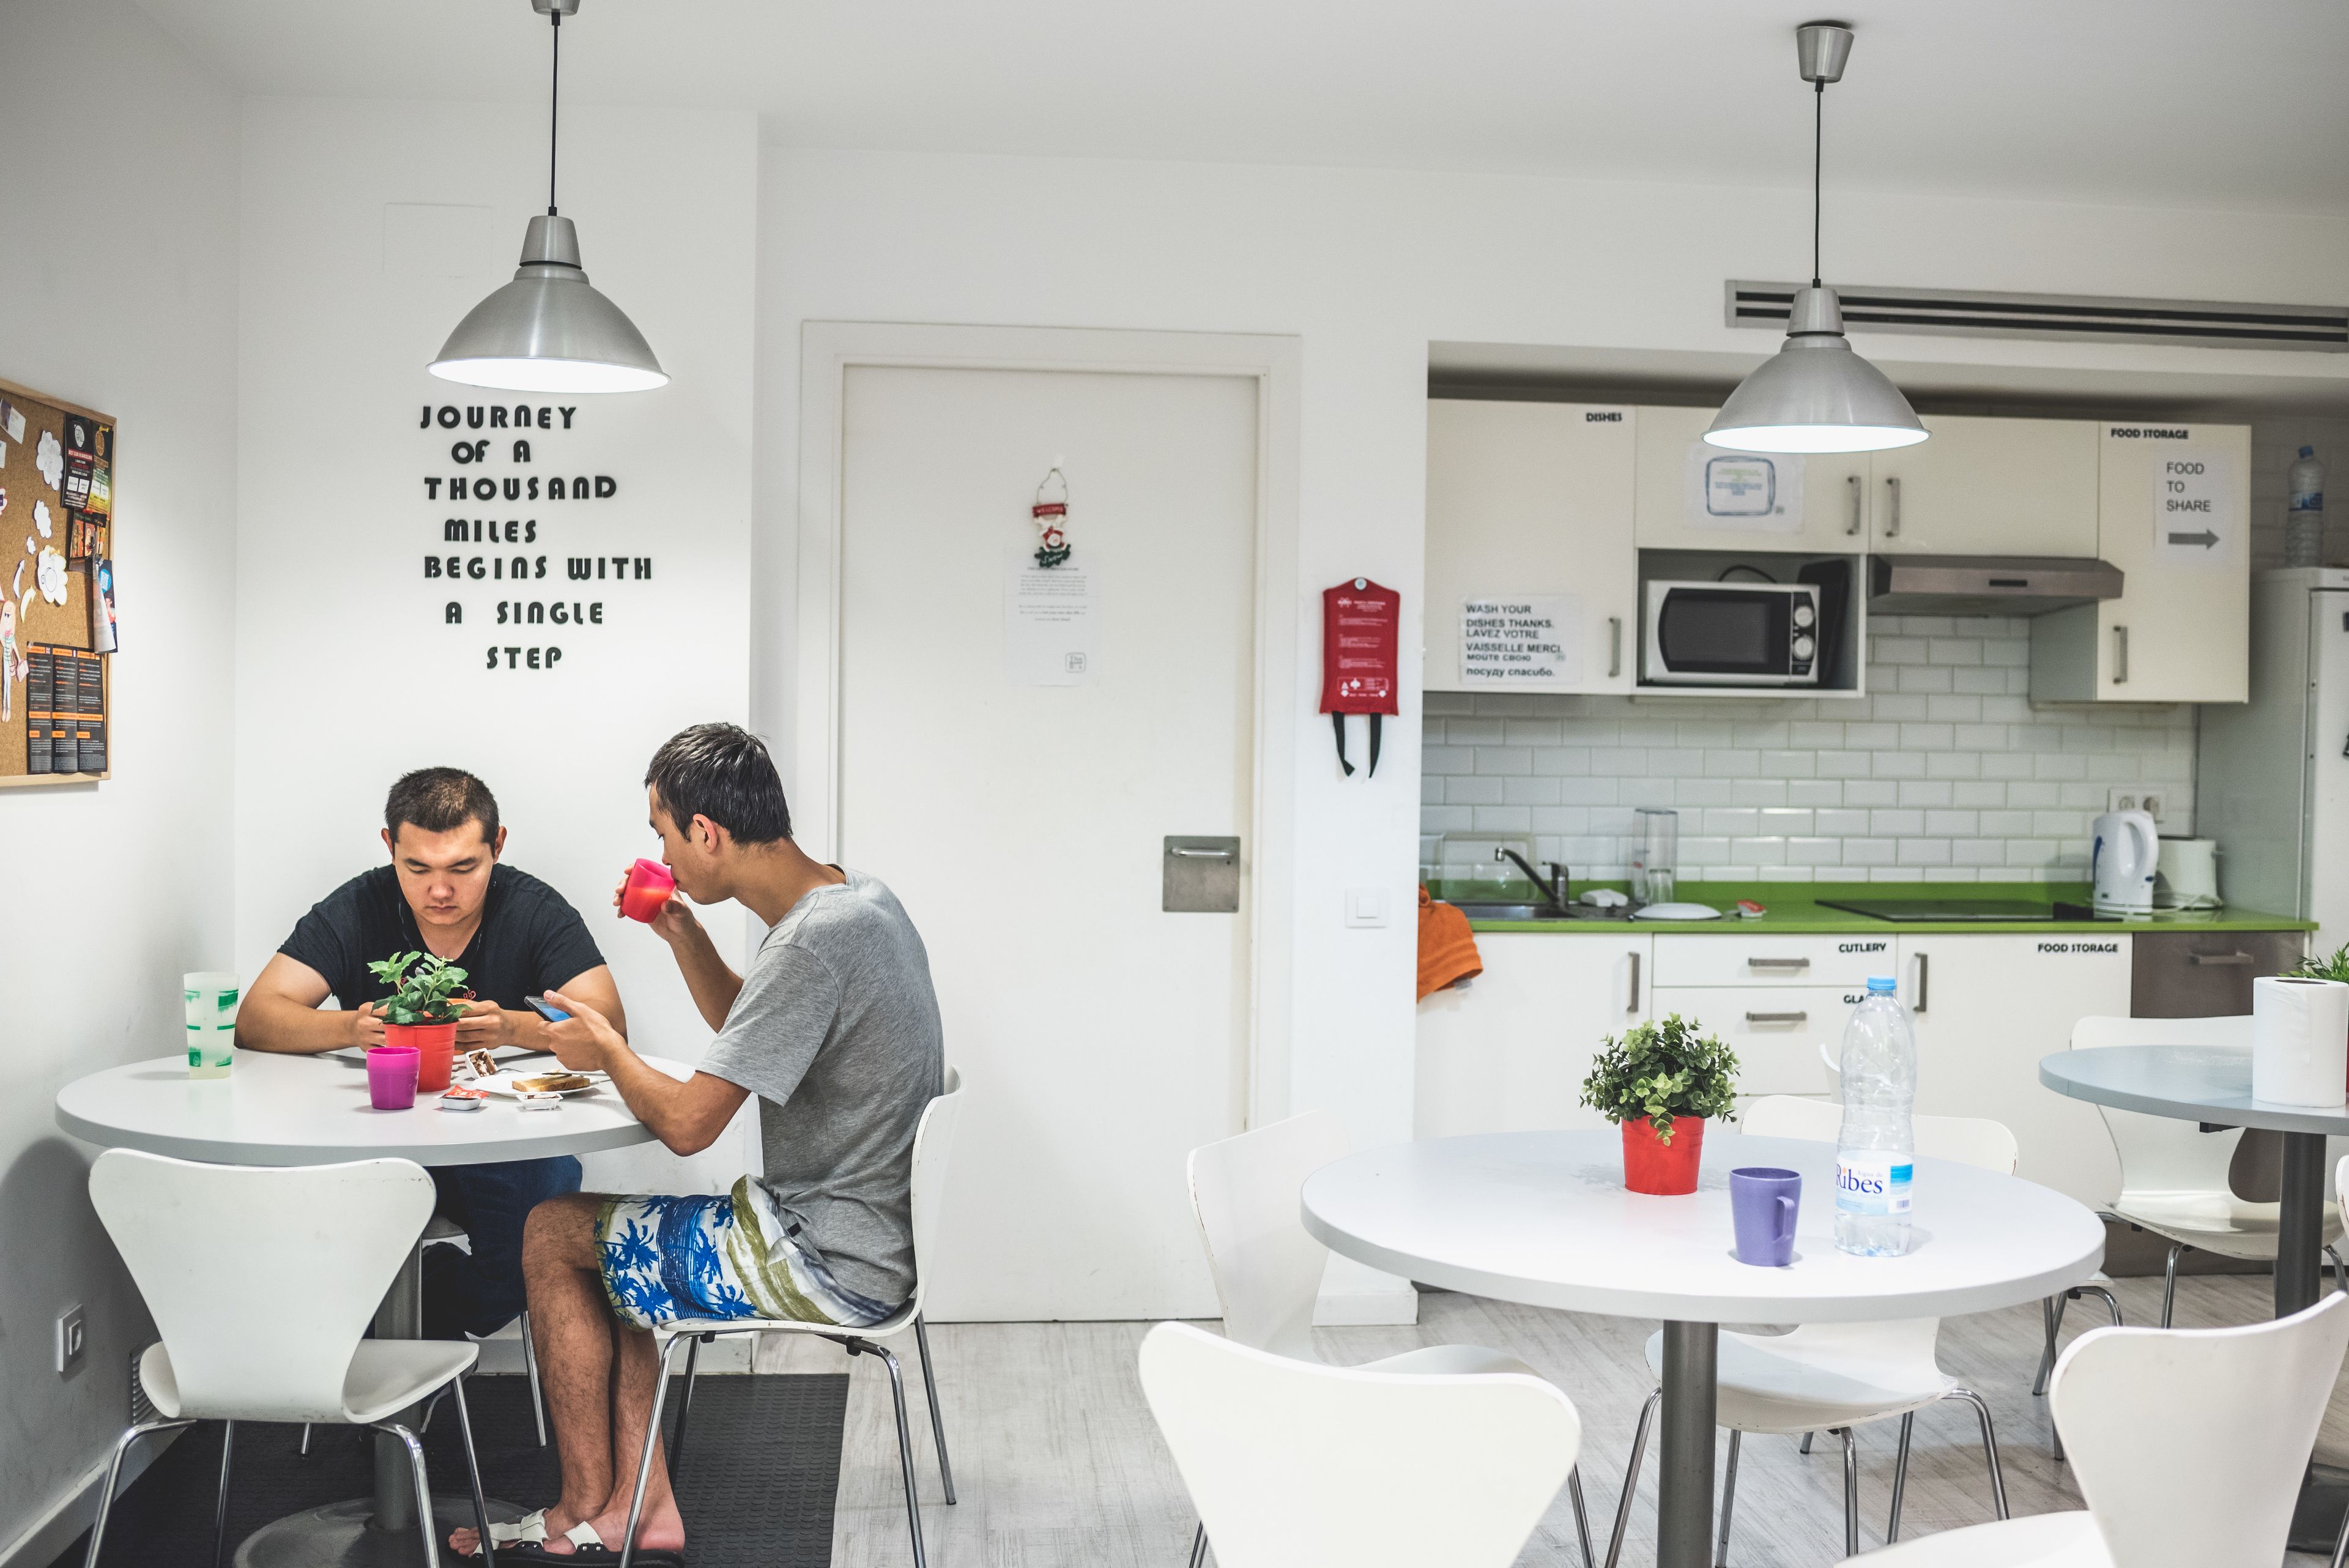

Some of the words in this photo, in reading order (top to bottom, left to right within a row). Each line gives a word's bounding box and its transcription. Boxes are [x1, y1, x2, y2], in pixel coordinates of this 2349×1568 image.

[420, 405, 577, 429] JOURNEY
[1586, 412, 1623, 422] DISHES
[2110, 428, 2141, 438] FOOD
[2143, 429, 2189, 439] STORAGE
[451, 439, 490, 464] OF
[513, 439, 531, 463] A
[2166, 461, 2205, 475] FOOD
[424, 475, 617, 500] THOUSAND
[2166, 480, 2185, 493] TO
[2166, 499, 2211, 513] SHARE
[444, 519, 536, 543] MILES
[424, 555, 547, 579] BEGINS
[567, 557, 652, 580] WITH
[445, 601, 462, 624] A
[497, 601, 603, 625] SINGLE
[1466, 604, 1499, 614] WASH
[1501, 604, 1532, 614] YOUR
[1466, 619, 1505, 628] DISHES
[1466, 629, 1501, 639] LAVEZ
[1503, 630, 1540, 639] VOTRE
[1466, 643, 1524, 653] VAISSELLE
[487, 646, 562, 669] STEP
[1838, 942, 1887, 953] CUTLERY
[2037, 943, 2069, 953] FOOD
[2071, 943, 2119, 953] STORAGE
[1843, 994, 1865, 1004] GLA
[1836, 1162, 1883, 1194] Ribes
